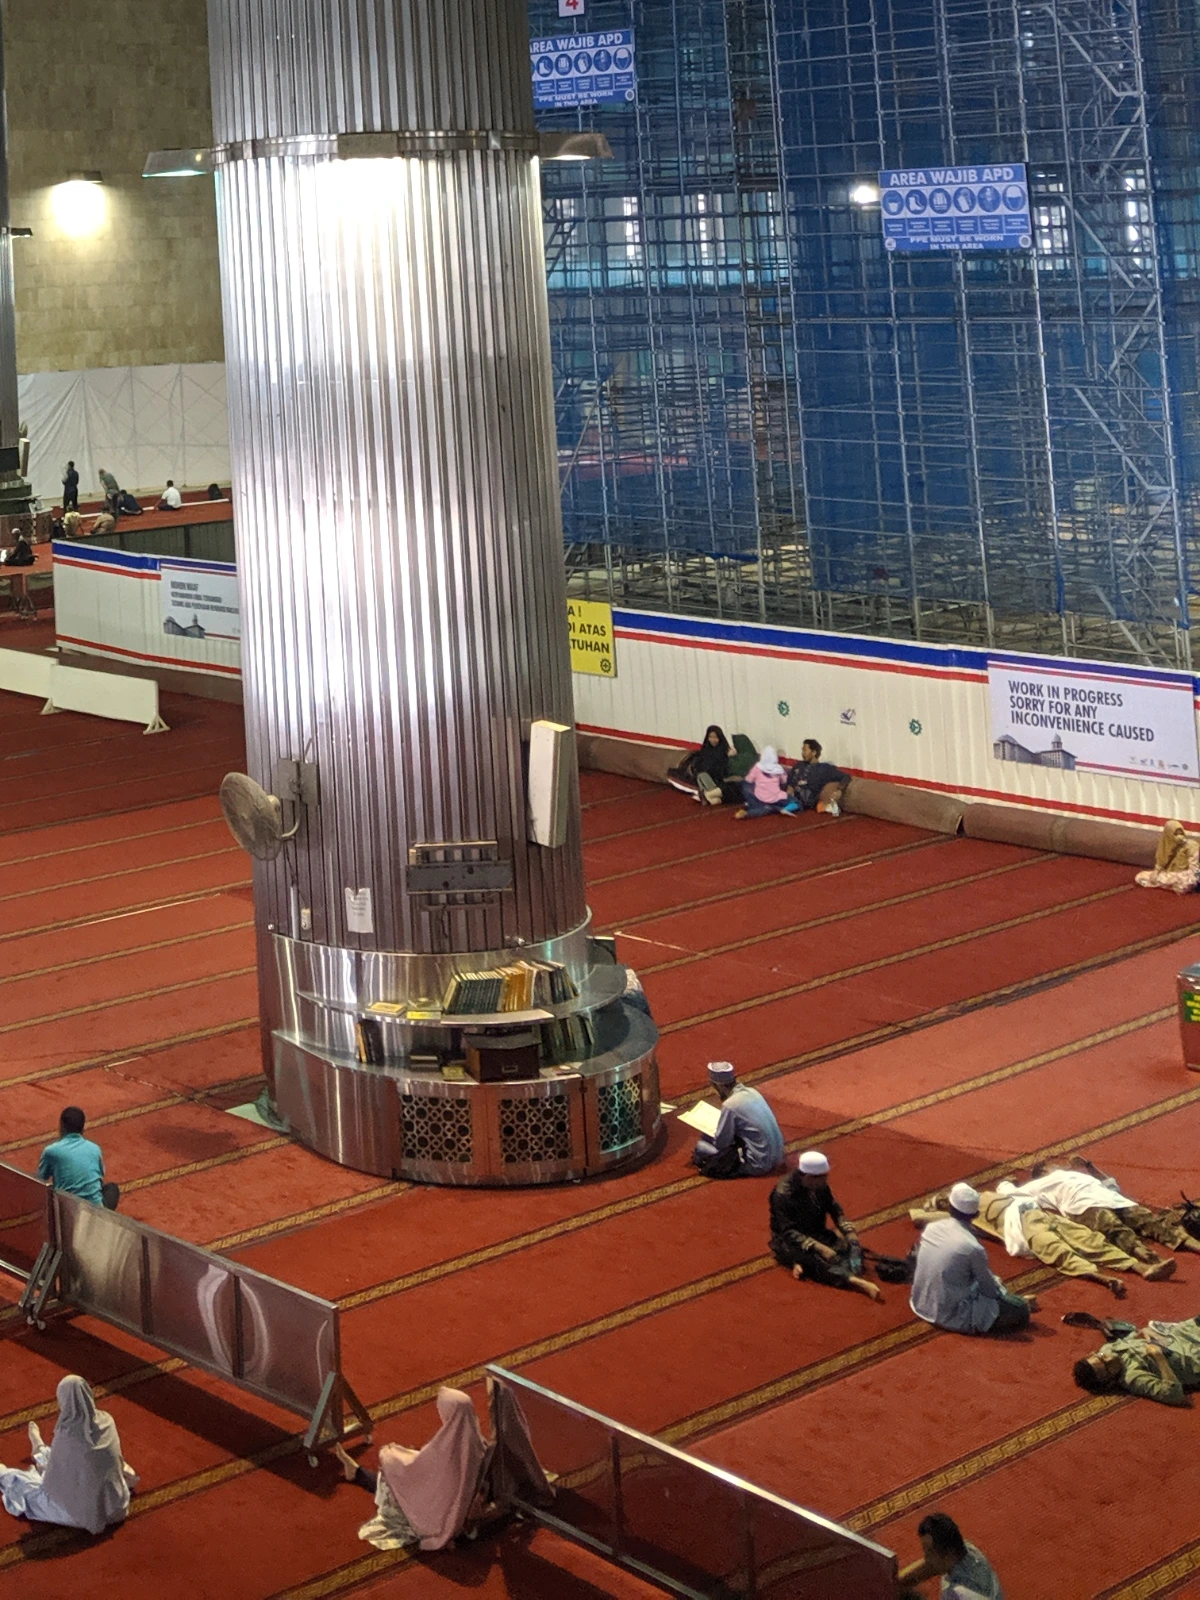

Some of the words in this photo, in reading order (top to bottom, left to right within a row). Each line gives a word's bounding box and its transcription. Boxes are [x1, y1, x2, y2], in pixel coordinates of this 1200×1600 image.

[530, 40, 554, 53] REA
[556, 35, 595, 50] WAJIB
[598, 33, 624, 46] APD
[889, 171, 927, 186] AREA
[930, 169, 978, 185] WAJIB
[982, 167, 1014, 182] APD
[579, 623, 606, 637] ATAS
[1008, 680, 1044, 697] WORK
[1047, 685, 1060, 699] IN
[1064, 687, 1124, 707] PROGRESS
[1009, 696, 1045, 712] SORRY
[1048, 700, 1072, 716] FOR
[1074, 705, 1098, 719] ANY
[1011, 710, 1105, 736] INCONVENIENCE
[1108, 723, 1155, 742] CAUSED
